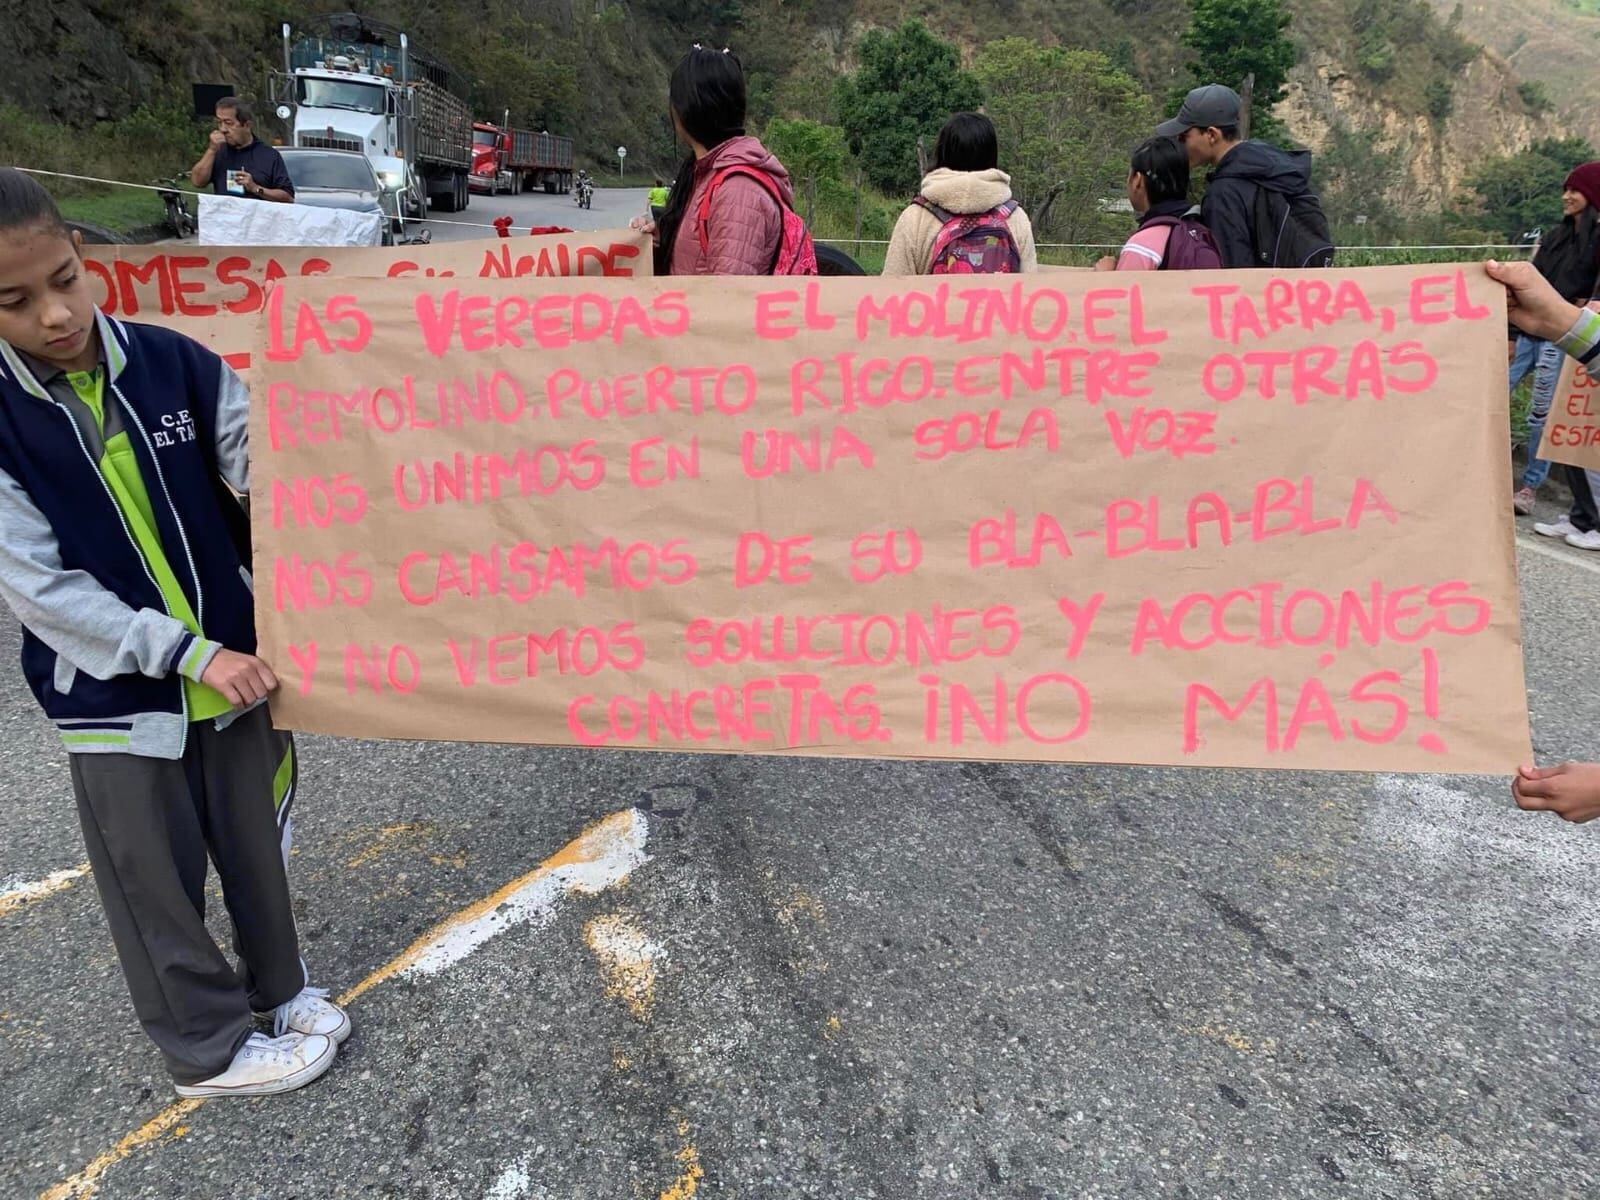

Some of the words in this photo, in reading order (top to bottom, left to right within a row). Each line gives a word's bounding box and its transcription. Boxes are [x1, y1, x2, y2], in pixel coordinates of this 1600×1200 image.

[263, 284, 374, 362] LAS
[414, 288, 692, 358] VEREDAS
[753, 281, 836, 340] EL
[1083, 283, 1169, 346] EL
[1190, 277, 1397, 346] TARRA,
[1408, 269, 1492, 325] EL
[545, 364, 758, 419] PUERTO
[952, 348, 1160, 405] ENTRE
[1202, 339, 1440, 406] OTRAS
[1567, 394, 1594, 417] EL
[152, 430, 175, 448] EL
[272, 473, 368, 530] NOS
[394, 439, 606, 511] UNIMOS
[629, 436, 700, 489] EN
[740, 426, 875, 479] UNA
[913, 408, 1060, 461] SOLA
[273, 551, 374, 612] NOS
[399, 536, 698, 606] CANSAMOS
[734, 531, 813, 589] DE
[849, 528, 923, 584] SU
[287, 641, 318, 696] Y
[342, 642, 421, 695] NO
[446, 620, 646, 688] VEMOS
[685, 603, 1021, 668] SOLUCIONES
[1056, 592, 1106, 661] Y
[1130, 580, 1492, 656] ACCIONES
